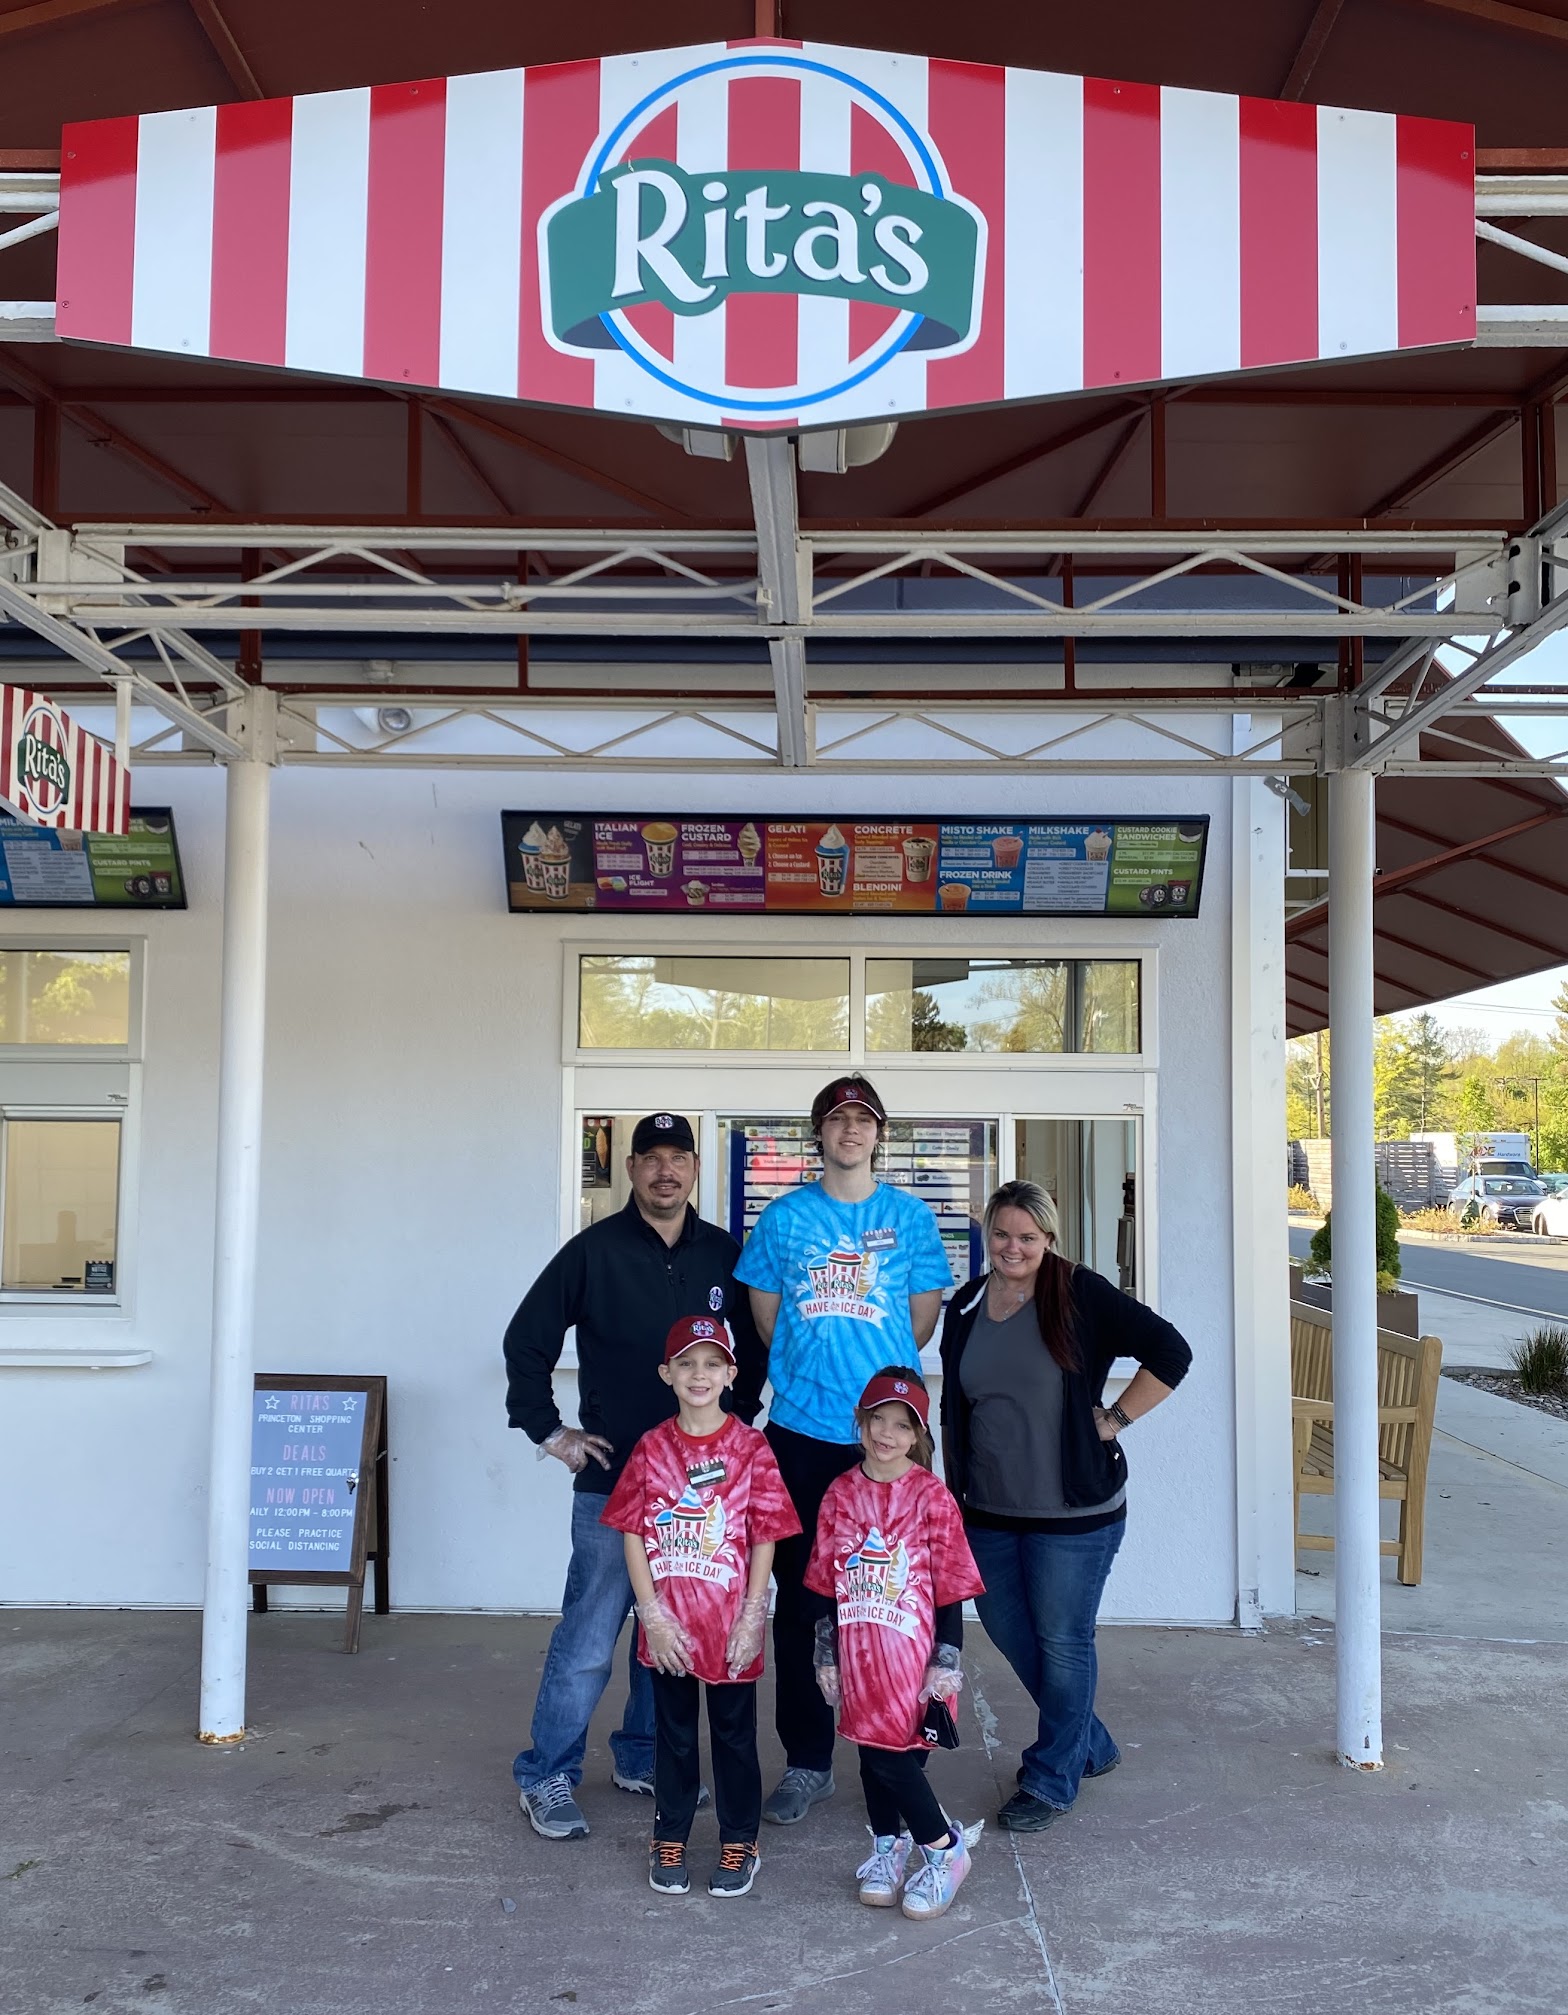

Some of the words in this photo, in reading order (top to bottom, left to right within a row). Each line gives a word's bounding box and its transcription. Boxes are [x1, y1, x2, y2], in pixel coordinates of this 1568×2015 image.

[610, 169, 931, 304] Rita's
[25, 733, 65, 789] Rita's
[594, 823, 638, 832] ITALIAN
[681, 824, 725, 833] FROZEN
[768, 824, 806, 833] GELATI
[854, 826, 913, 834] CONCRETE
[941, 826, 974, 834] MISTO
[976, 826, 1013, 834] SHAKE
[596, 832, 613, 840] ICE
[681, 833, 732, 841] CUSTARD
[940, 871, 980, 879] FROZEN
[982, 871, 1012, 879] DRINK
[853, 883, 902, 891] BLENDINI
[805, 1302, 828, 1315] HAVE
[841, 1302, 856, 1314] ICE
[858, 1305, 876, 1318] DAY
[258, 1414, 301, 1422] PRINCETON
[310, 1415, 352, 1423] SHOPPING
[288, 1425, 323, 1433] CENTER
[283, 1445, 326, 1461] DEALS
[250, 1467, 266, 1475] BUY
[267, 1467, 273, 1475] 2
[276, 1467, 293, 1476] GET
[301, 1468, 323, 1476] FREE
[266, 1488, 295, 1504] NOW
[302, 1488, 334, 1504] OPEN
[249, 1508, 268, 1516] AILY
[256, 1528, 291, 1537] PLEASE
[298, 1529, 343, 1538] PRACTICE
[249, 1541, 282, 1550] SOCIAL
[288, 1542, 340, 1551] DISTANCING
[685, 1562, 701, 1574] ICE
[703, 1565, 722, 1578] DAY
[868, 1606, 884, 1619] ICE
[887, 1610, 906, 1626] DAY
